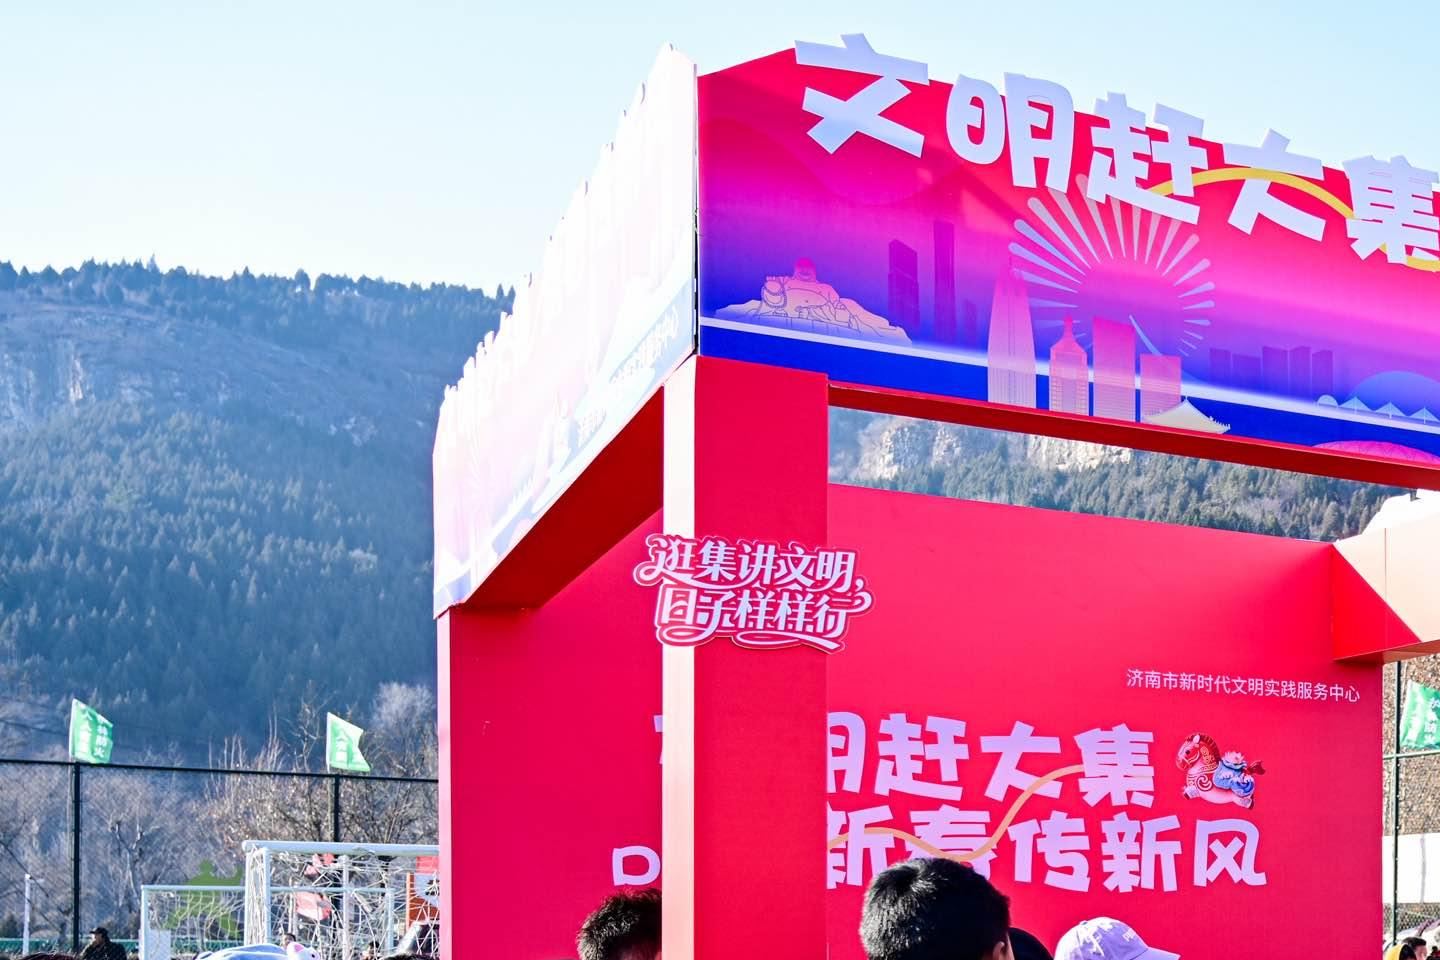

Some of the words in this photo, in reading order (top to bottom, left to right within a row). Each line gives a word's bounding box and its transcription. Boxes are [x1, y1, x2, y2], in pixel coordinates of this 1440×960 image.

[795, 33, 1440, 264] 文明赶大集
[660, 587, 872, 650] 日子样样行
[1126, 669, 1361, 703] 济南市新时代文明实践服务中心
